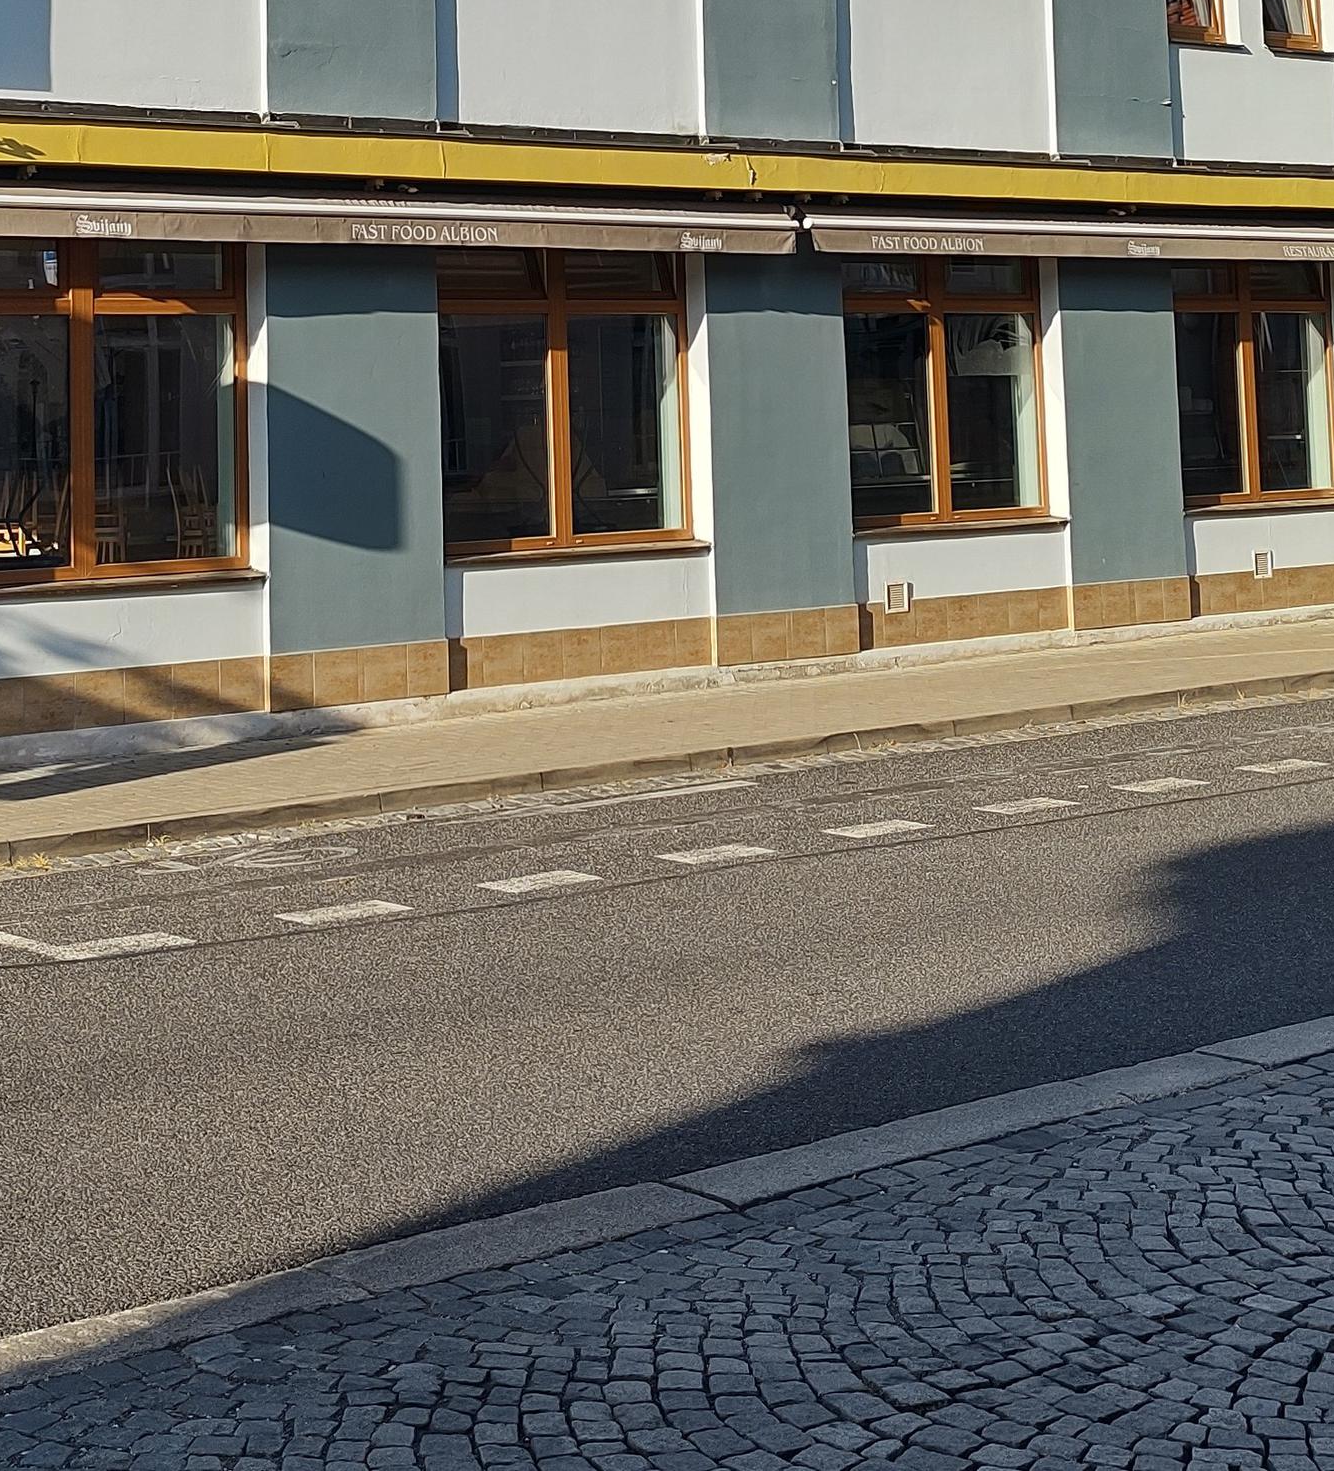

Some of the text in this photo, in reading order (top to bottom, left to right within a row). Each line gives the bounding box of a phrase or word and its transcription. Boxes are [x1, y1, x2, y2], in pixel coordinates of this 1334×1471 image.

[351, 222, 388, 240] FAST
[391, 224, 437, 242] FOOD
[440, 225, 498, 243] ALBION
[871, 235, 985, 252] FAST FOOD ALBION
